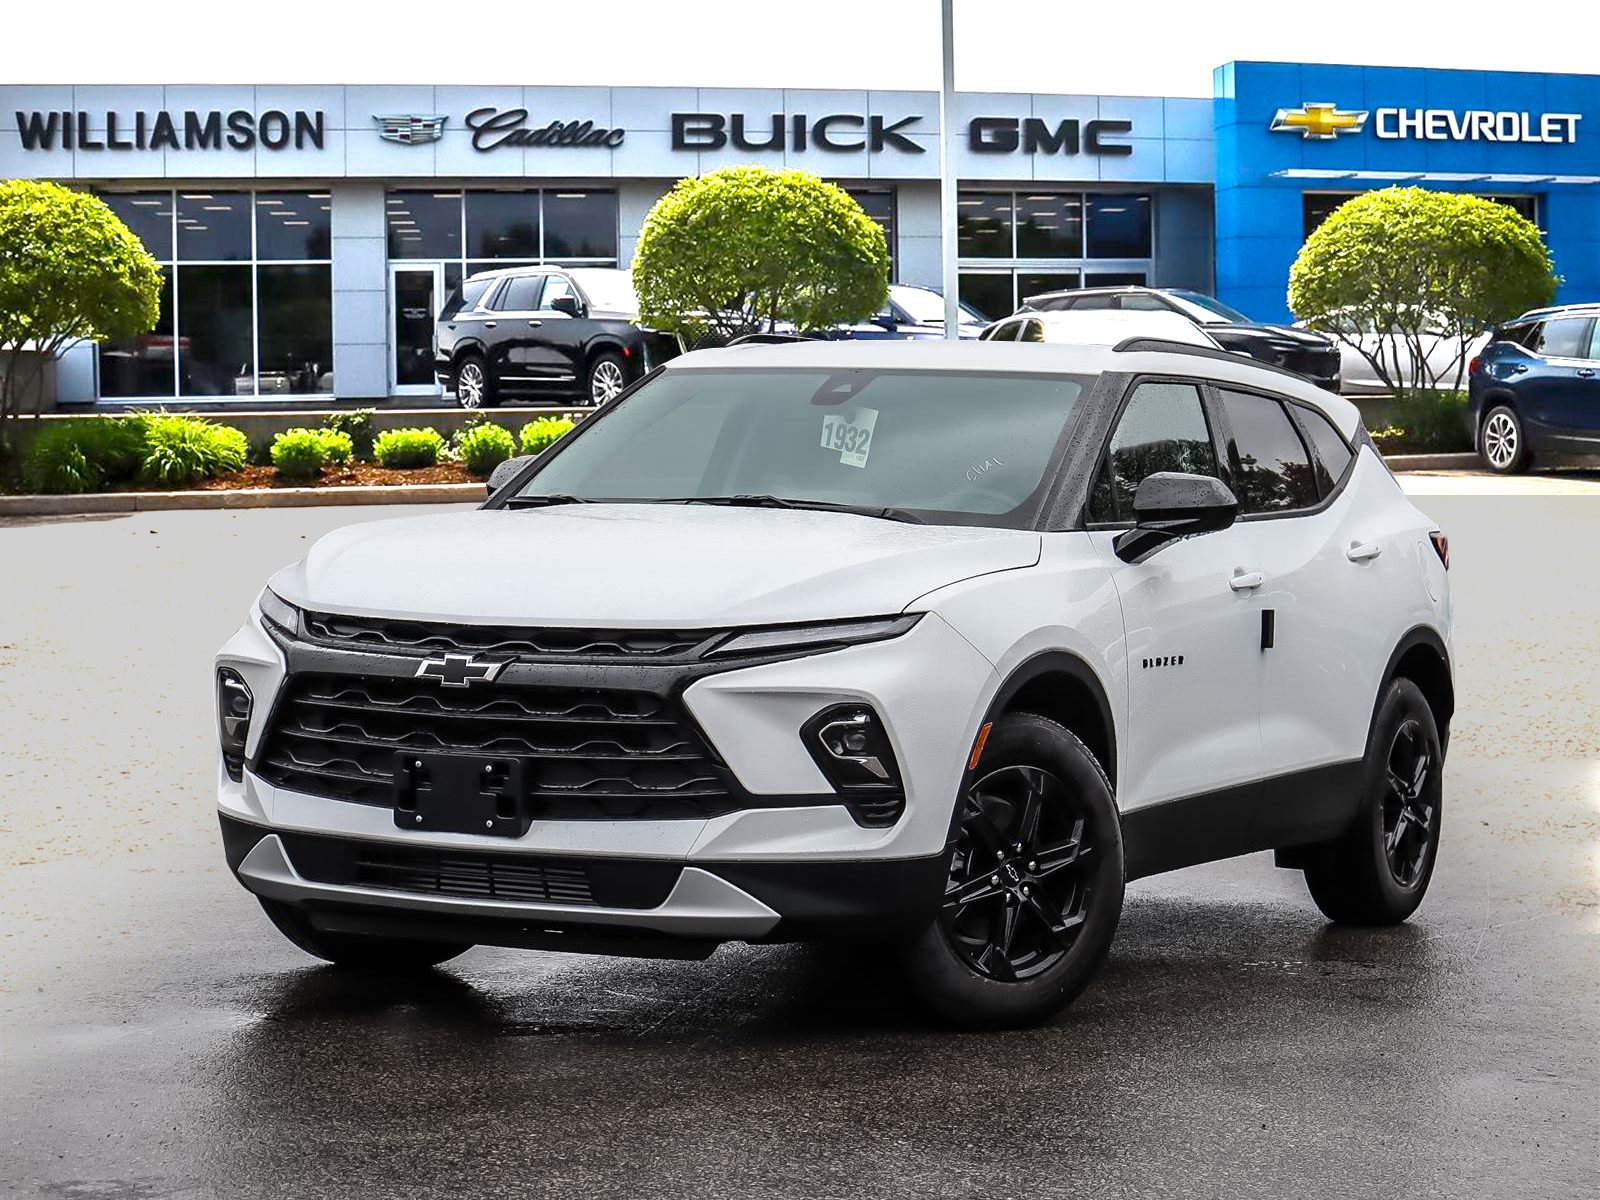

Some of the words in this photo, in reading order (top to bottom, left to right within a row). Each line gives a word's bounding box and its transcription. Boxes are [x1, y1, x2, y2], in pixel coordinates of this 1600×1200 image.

[16, 110, 324, 151] WILLIAMSON
[465, 107, 625, 152] Cadillac
[671, 113, 926, 154] BUICK
[969, 117, 1133, 156] GMC
[1376, 107, 1583, 144] CHEVROLET
[825, 422, 870, 456] 1932
[1142, 655, 1185, 669] BLAZER
